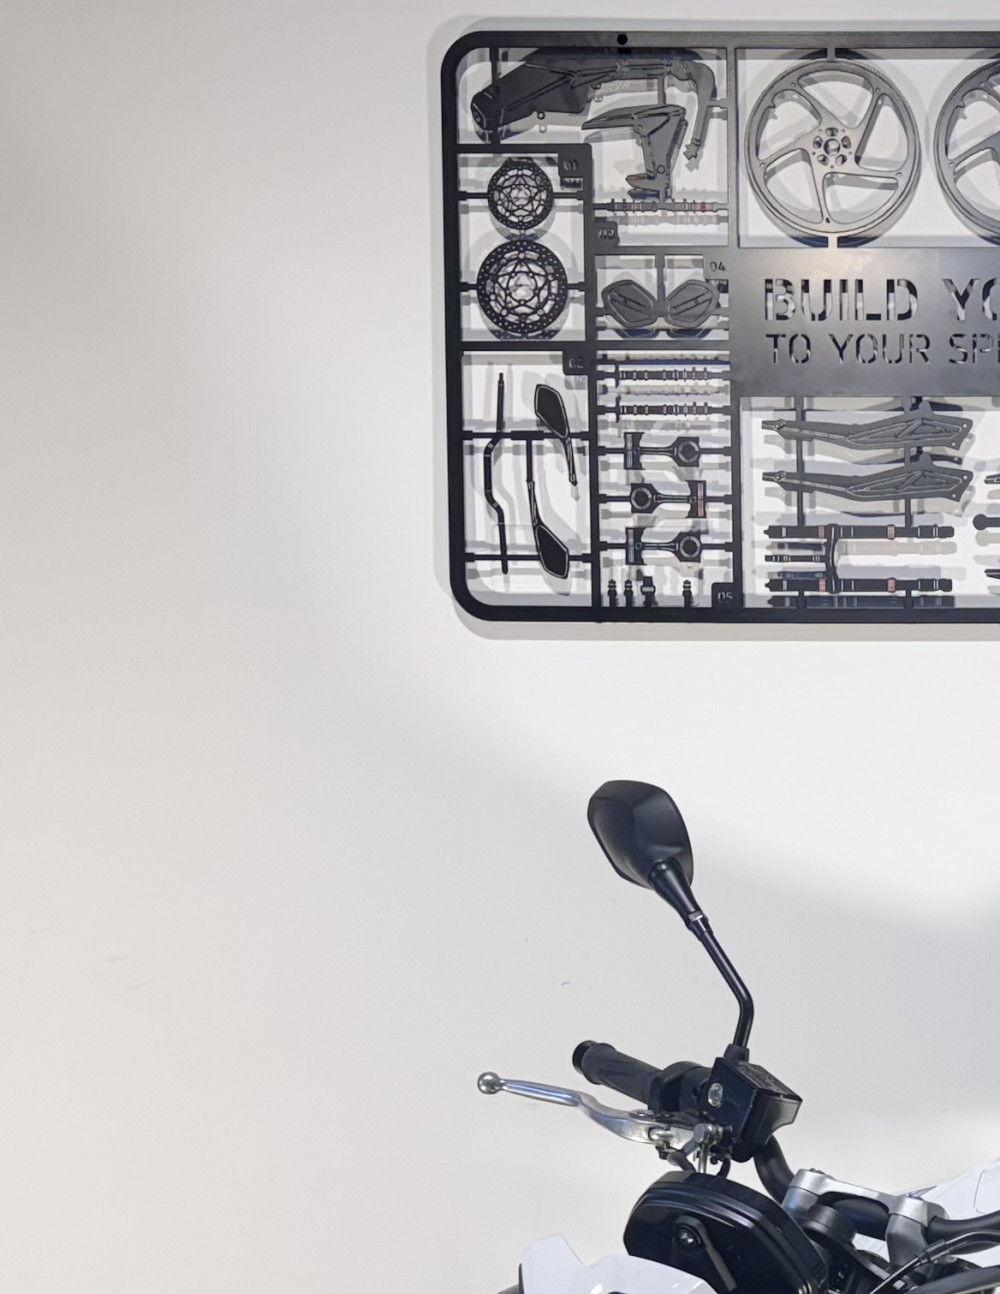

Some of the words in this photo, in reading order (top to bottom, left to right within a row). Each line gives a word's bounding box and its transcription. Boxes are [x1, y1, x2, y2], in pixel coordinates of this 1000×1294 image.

[709, 261, 726, 273] 04
[764, 278, 918, 322] BUILD
[766, 333, 811, 364] TO
[829, 333, 931, 364] YOUR
